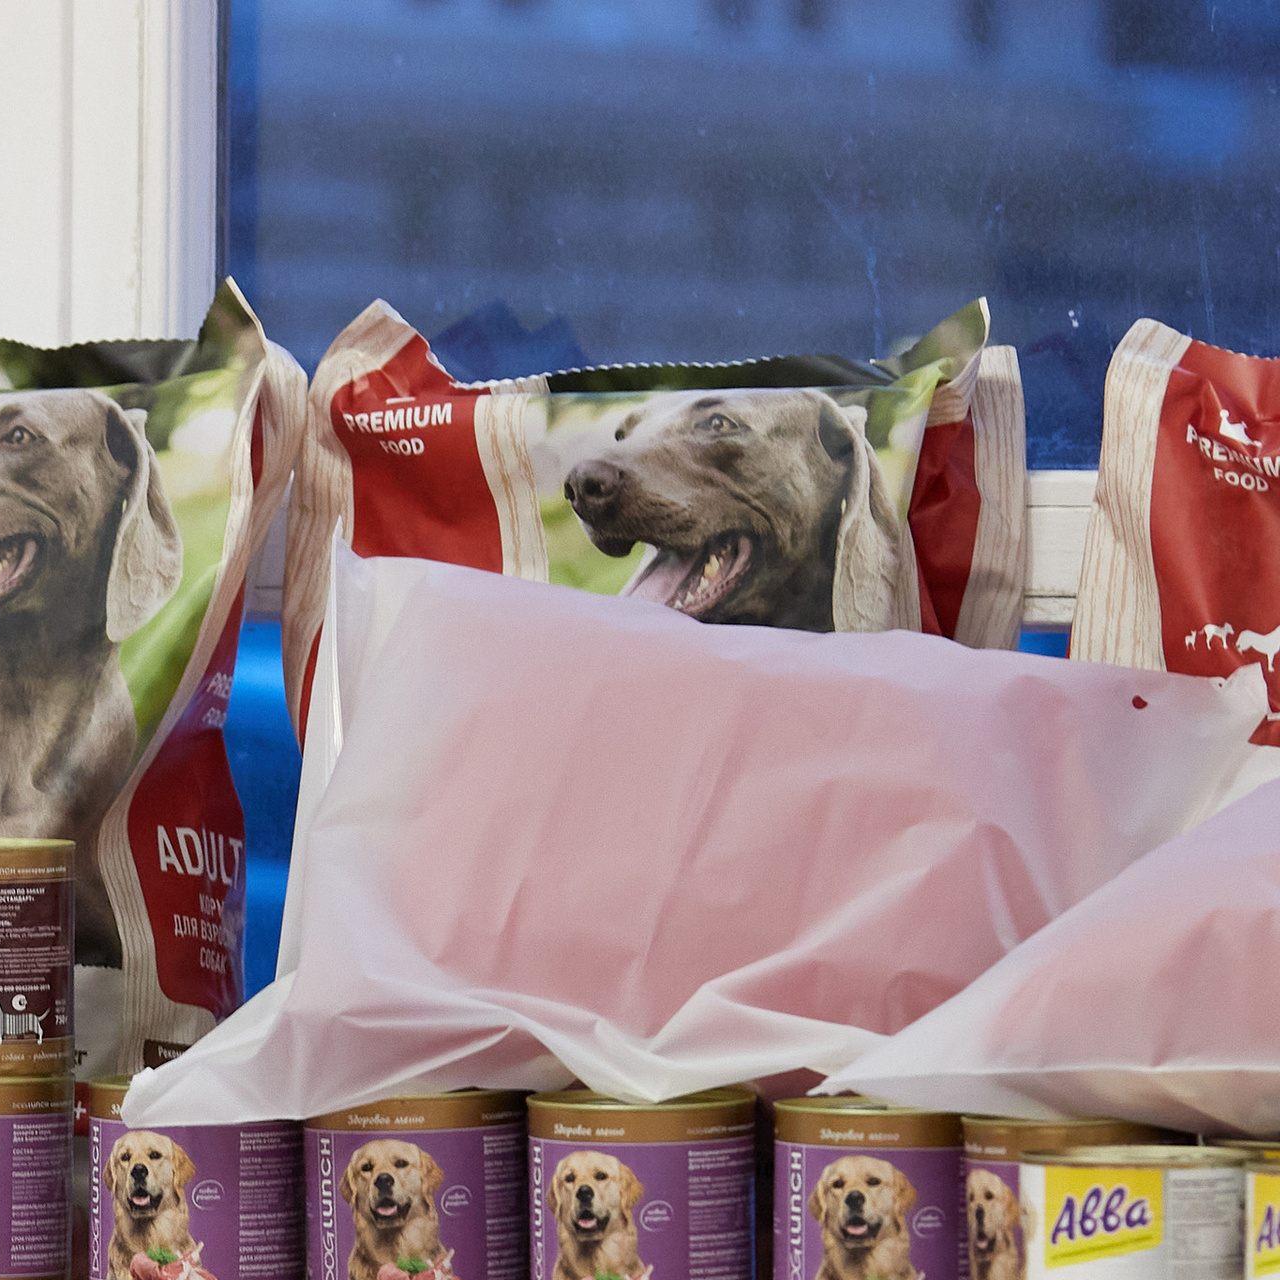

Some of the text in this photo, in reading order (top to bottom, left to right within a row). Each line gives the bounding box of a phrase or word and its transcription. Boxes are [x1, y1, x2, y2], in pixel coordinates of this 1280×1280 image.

[343, 403, 452, 433] PREMIUM
[379, 437, 425, 455] FOOD
[1214, 467, 1269, 492] FOOD
[157, 824, 242, 890] ADULT
[174, 914, 198, 937] ДЛЯ
